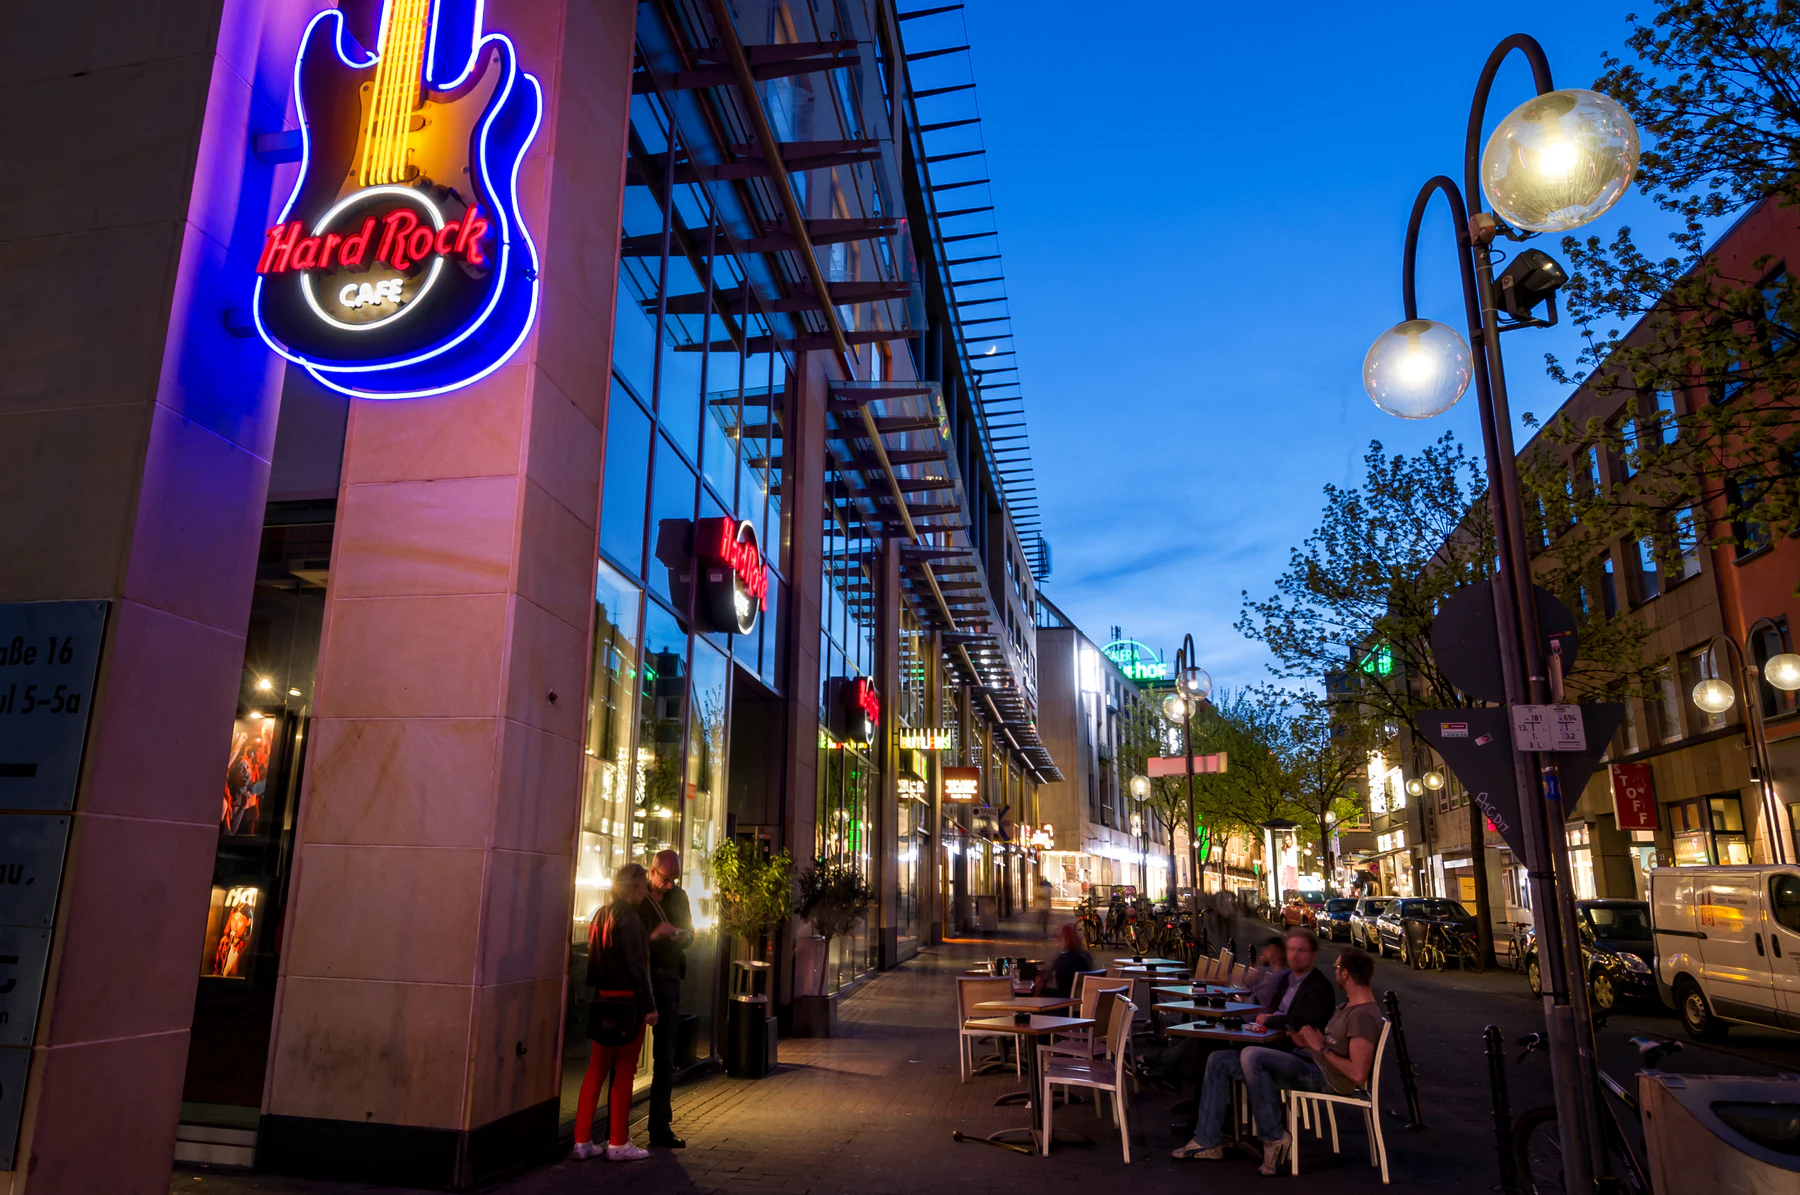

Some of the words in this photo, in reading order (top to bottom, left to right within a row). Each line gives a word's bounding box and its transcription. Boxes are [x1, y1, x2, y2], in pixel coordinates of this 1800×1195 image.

[256, 216, 377, 274] Hard
[375, 202, 488, 271] Rock
[339, 278, 404, 308] CAFE
[47, 636, 73, 665] 16
[1104, 648, 1140, 662] GALERA
[1612, 763, 1648, 825] STOFF
